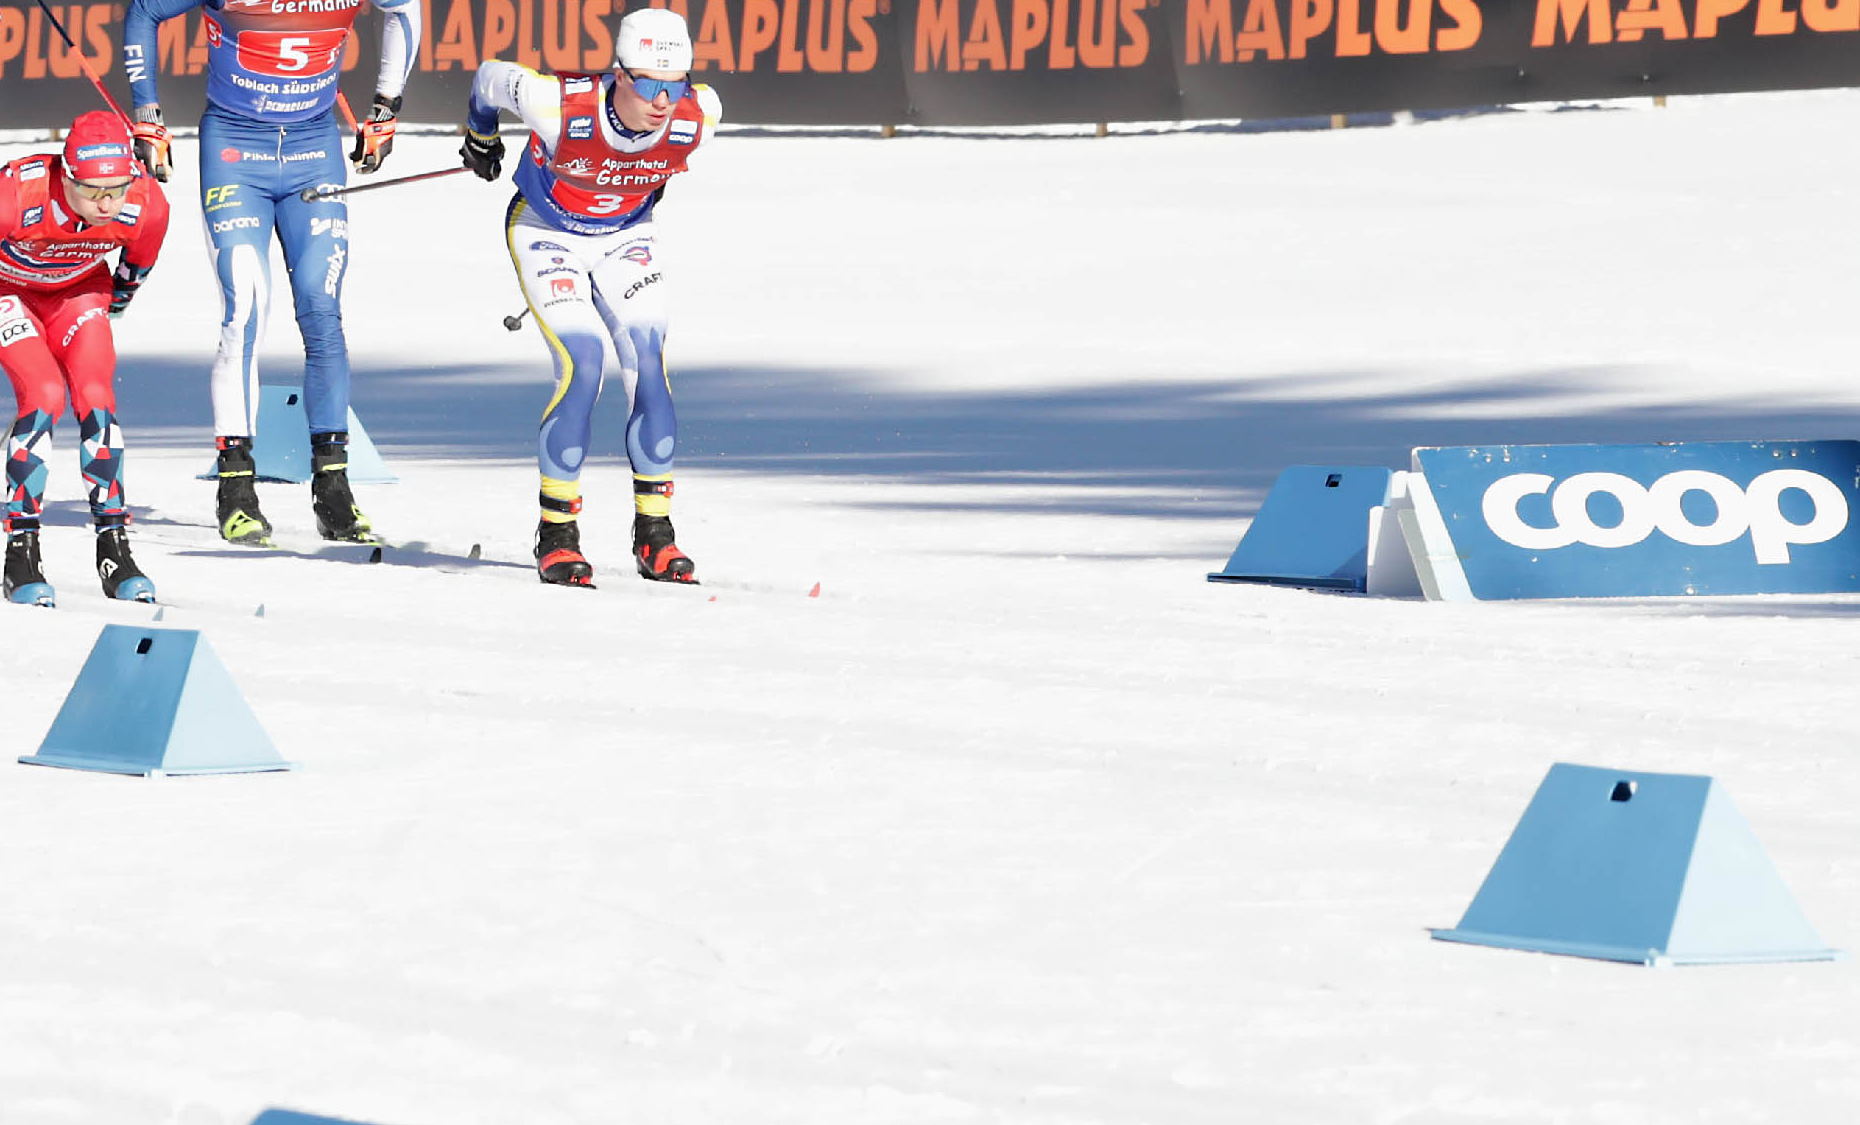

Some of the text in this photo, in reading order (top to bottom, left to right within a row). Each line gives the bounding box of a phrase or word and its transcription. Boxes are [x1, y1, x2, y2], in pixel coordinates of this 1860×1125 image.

[123, 44, 147, 84] FIN
[275, 37, 310, 71] 5
[230, 74, 280, 95] Toblach
[600, 158, 668, 172] Apparthotel
[586, 193, 624, 214] 3
[213, 216, 261, 234] barona
[1482, 468, 1849, 565] coop
